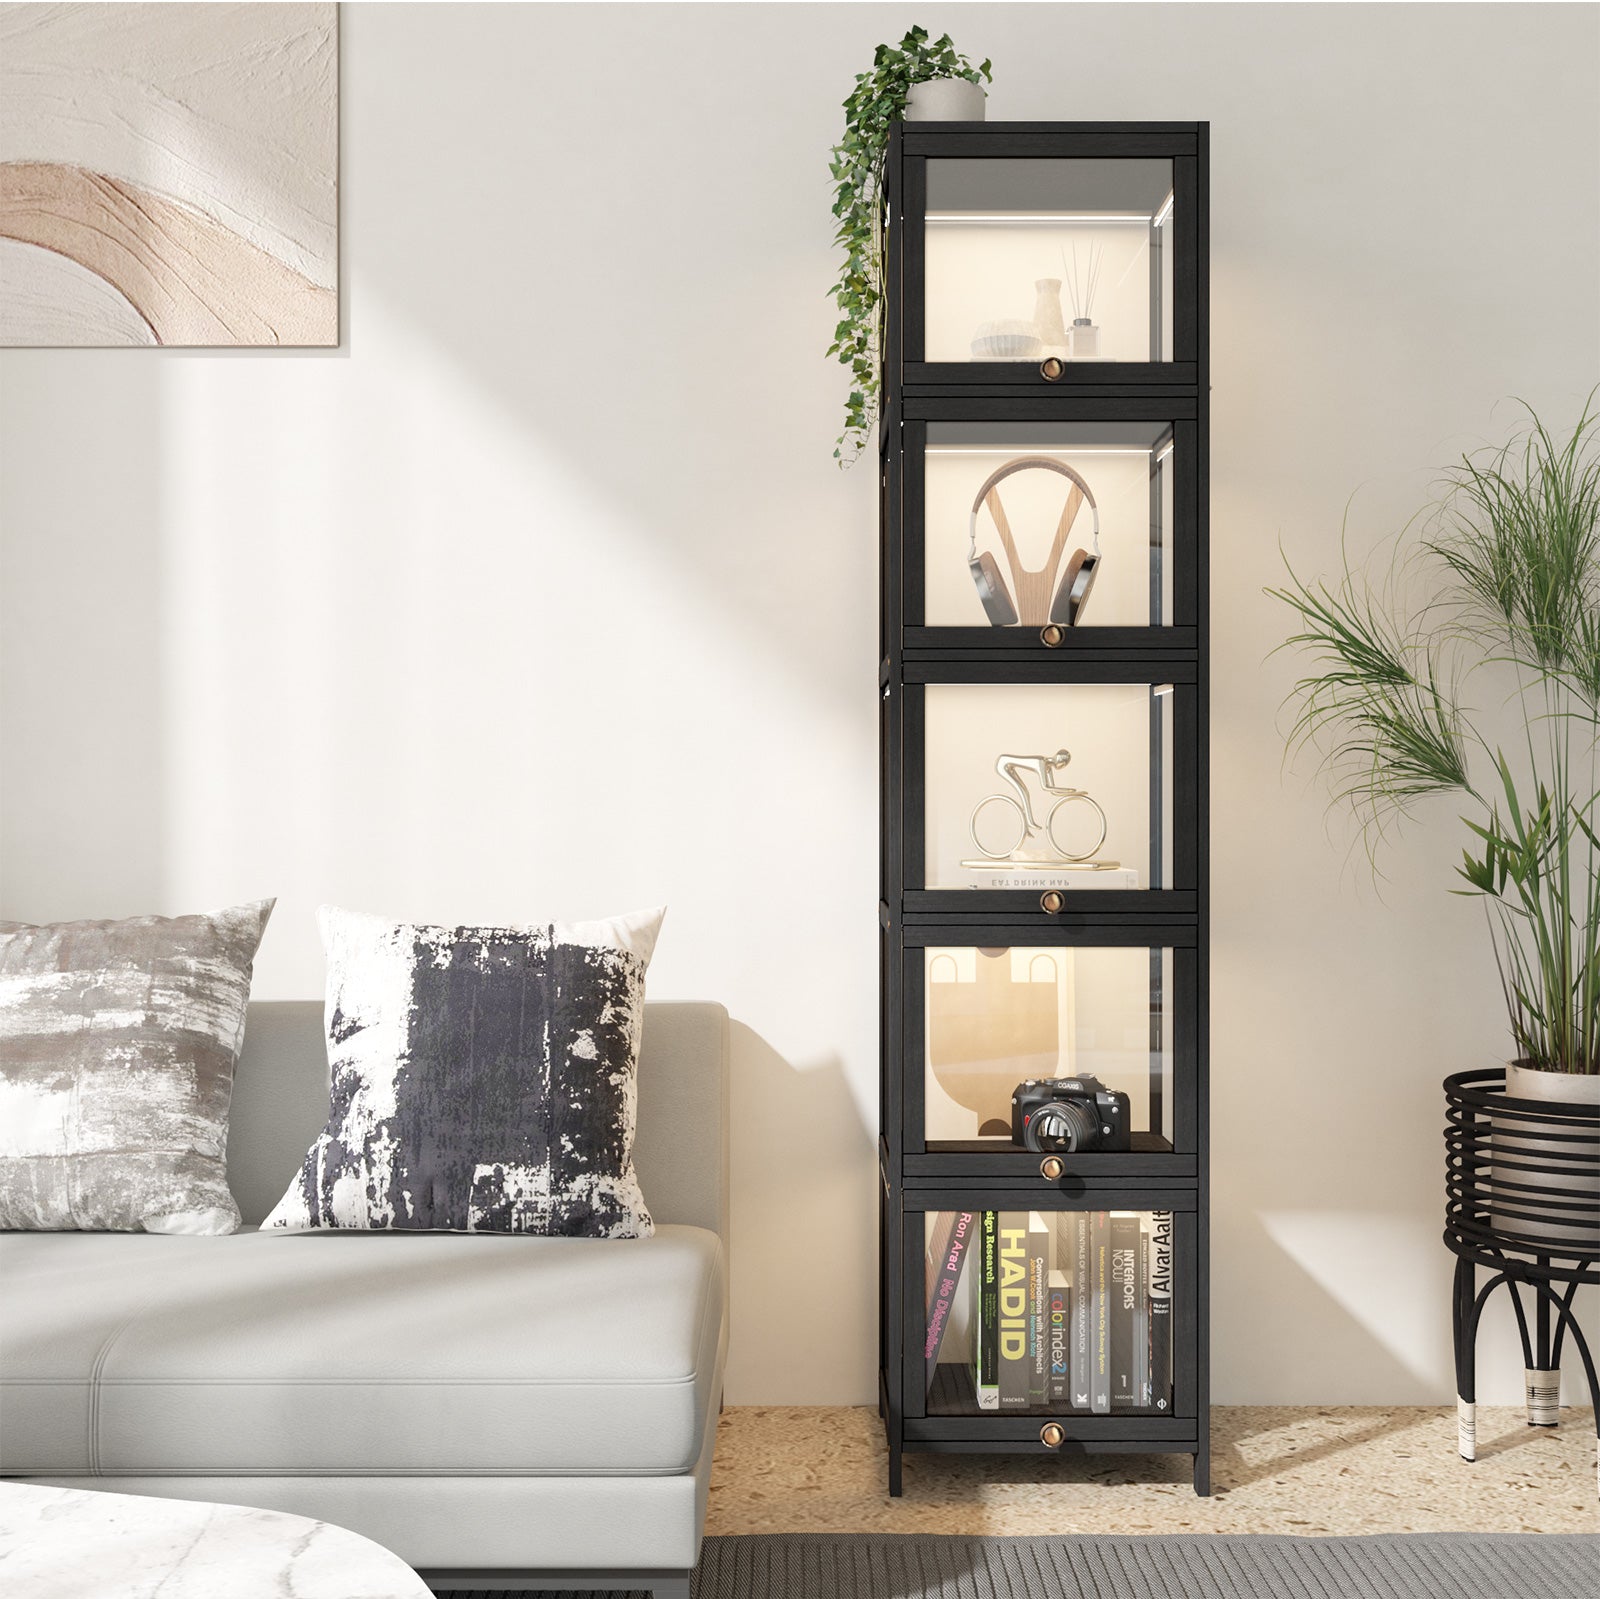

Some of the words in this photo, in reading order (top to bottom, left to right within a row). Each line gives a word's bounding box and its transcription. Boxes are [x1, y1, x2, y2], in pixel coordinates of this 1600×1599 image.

[956, 1212, 973, 1238] Ron
[947, 1240, 964, 1272] Arad
[986, 1235, 995, 1284] Research
[1152, 1248, 1170, 1292] Alvar
[940, 1278, 954, 1298] No
[1001, 1229, 1026, 1361] HADID
[1036, 1257, 1044, 1314] Conversations
[1123, 1249, 1134, 1310] INTERIORS
[1036, 1315, 1044, 1333] with
[1036, 1334, 1044, 1375] Architects
